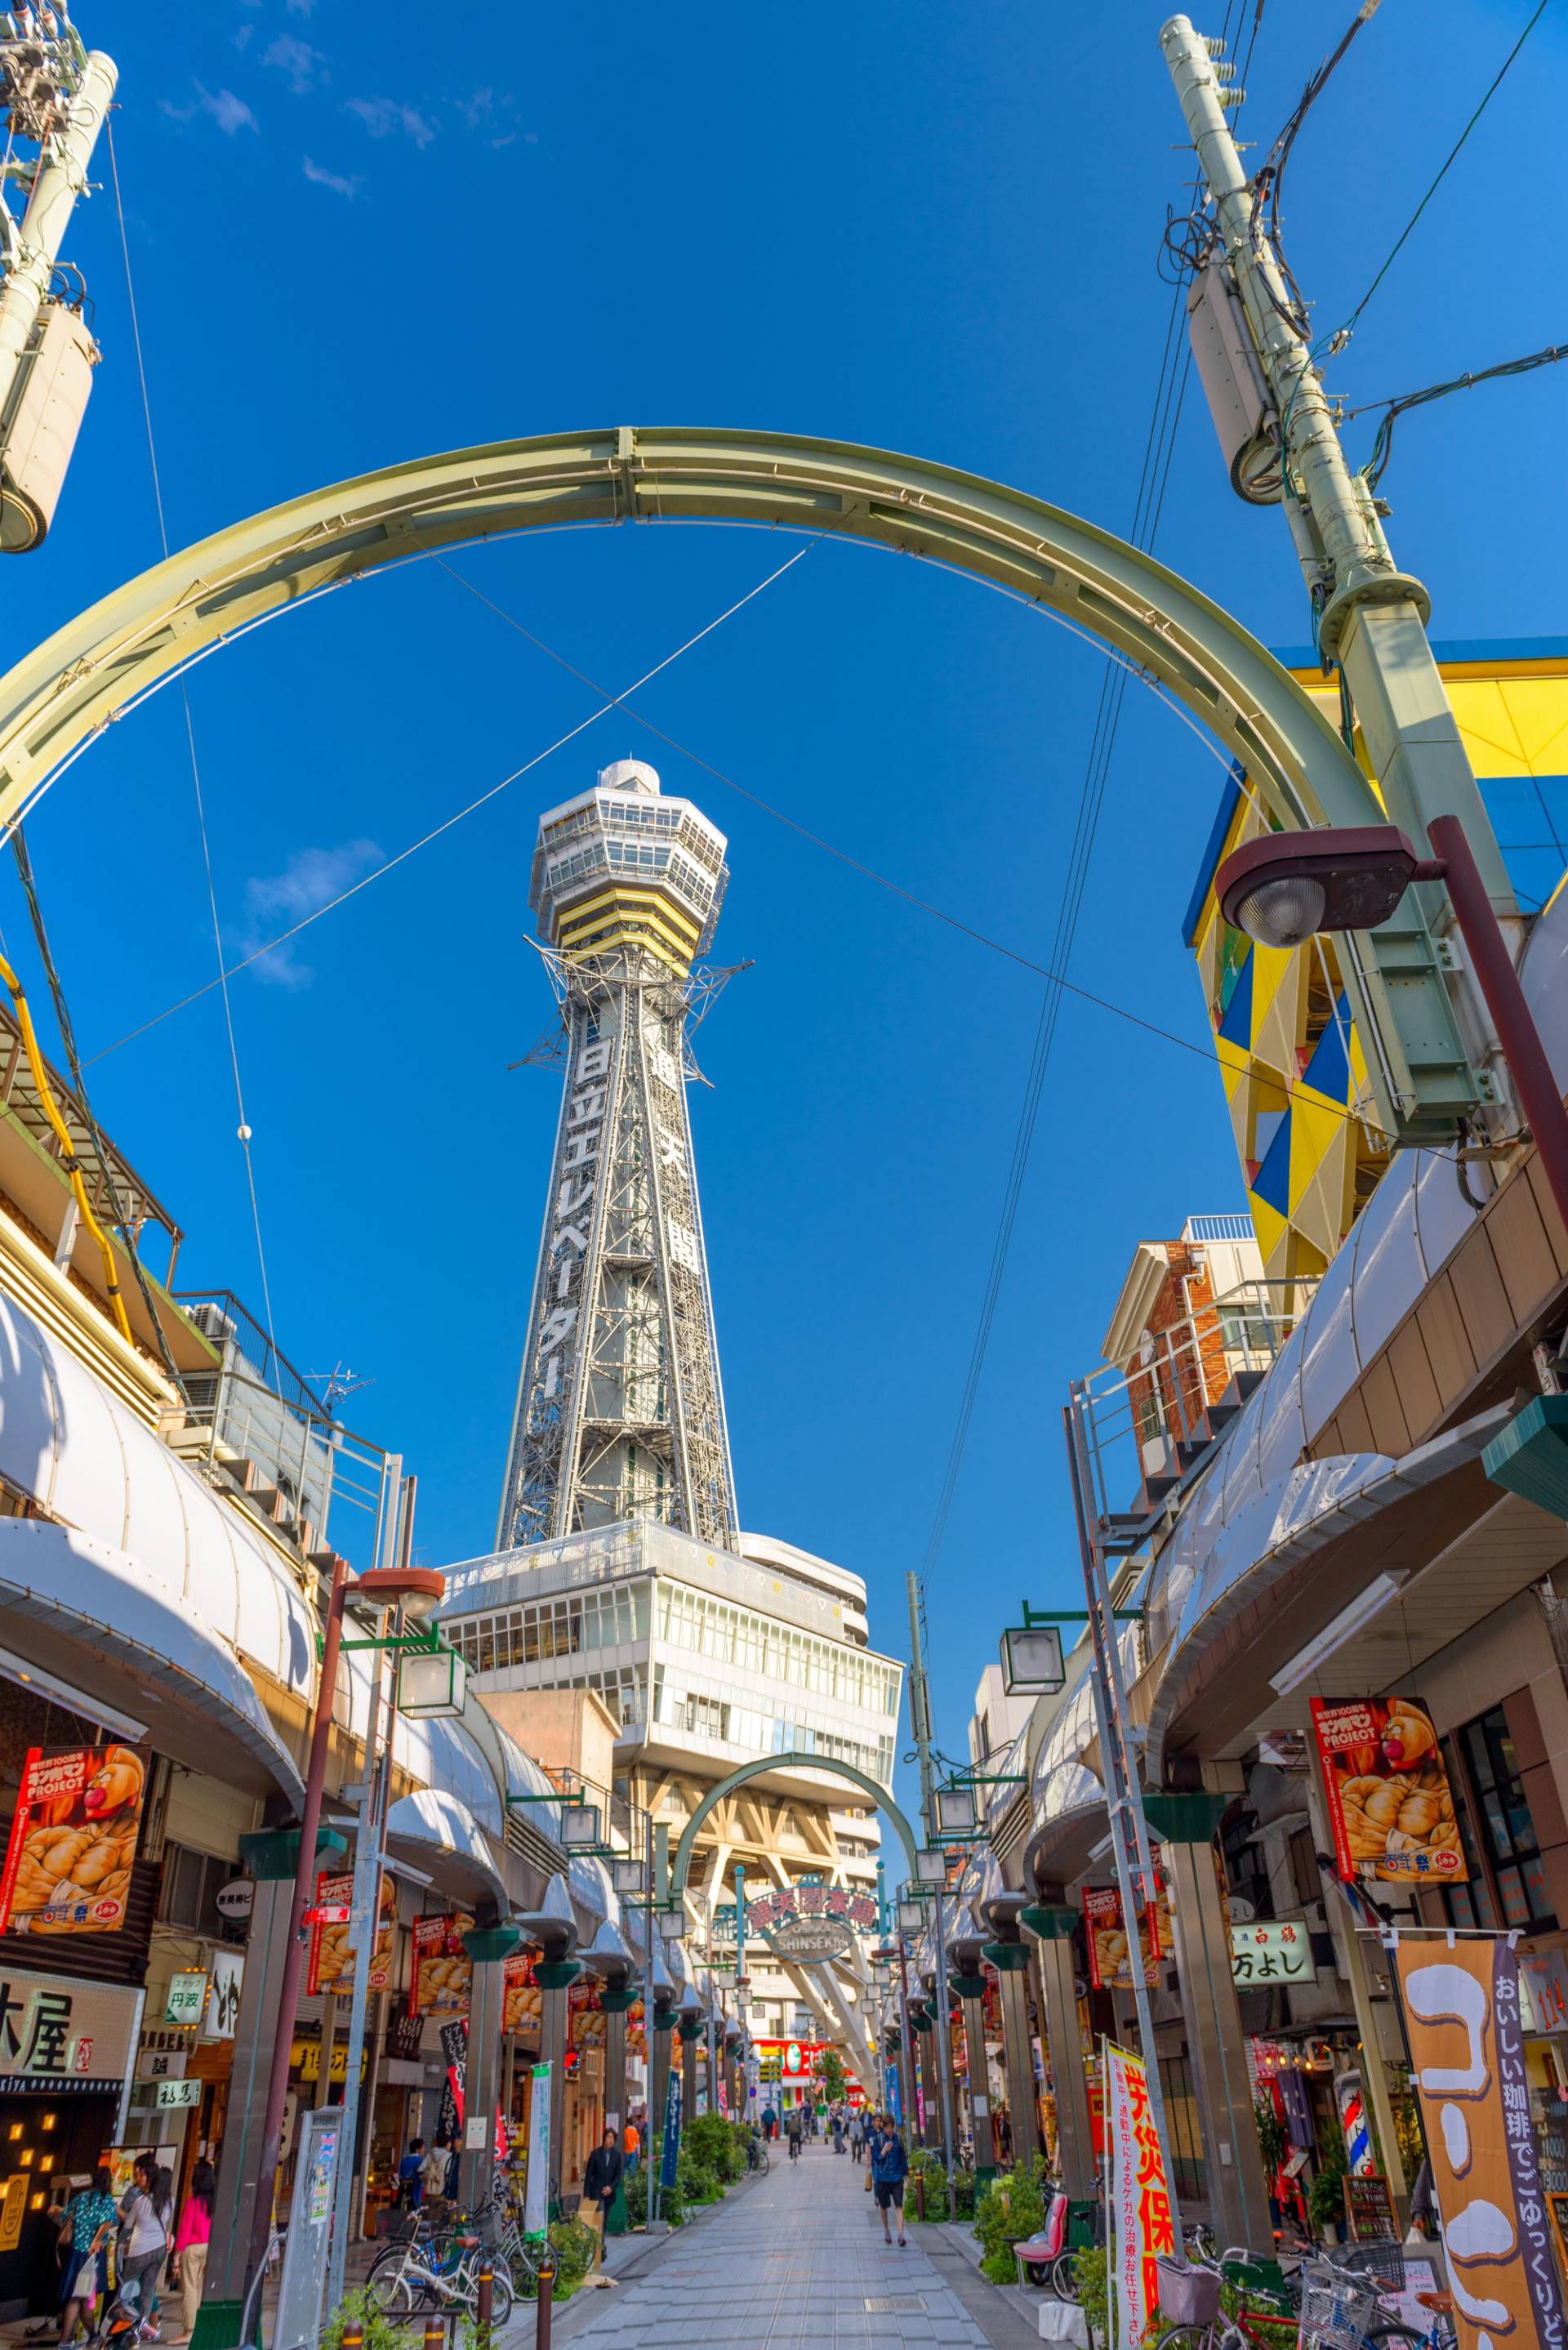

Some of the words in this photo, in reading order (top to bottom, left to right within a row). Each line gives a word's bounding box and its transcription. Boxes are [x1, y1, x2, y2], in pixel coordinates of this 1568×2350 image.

[649, 1044, 700, 1276] 通天閣
[538, 1040, 612, 1398] 日立エレベーター
[1318, 1713, 1371, 1735] キン肉マン
[1323, 1728, 1375, 1747] PROJECT
[27, 1777, 84, 1799] PROJECT
[745, 1887, 876, 1929] 通天閣本通
[1233, 1951, 1306, 1979] 万よし
[174, 1978, 201, 1988] スナック
[171, 1991, 198, 2008] 丹波
[1495, 1975, 1563, 2350] おいしい珈琲でごゆっくりど
